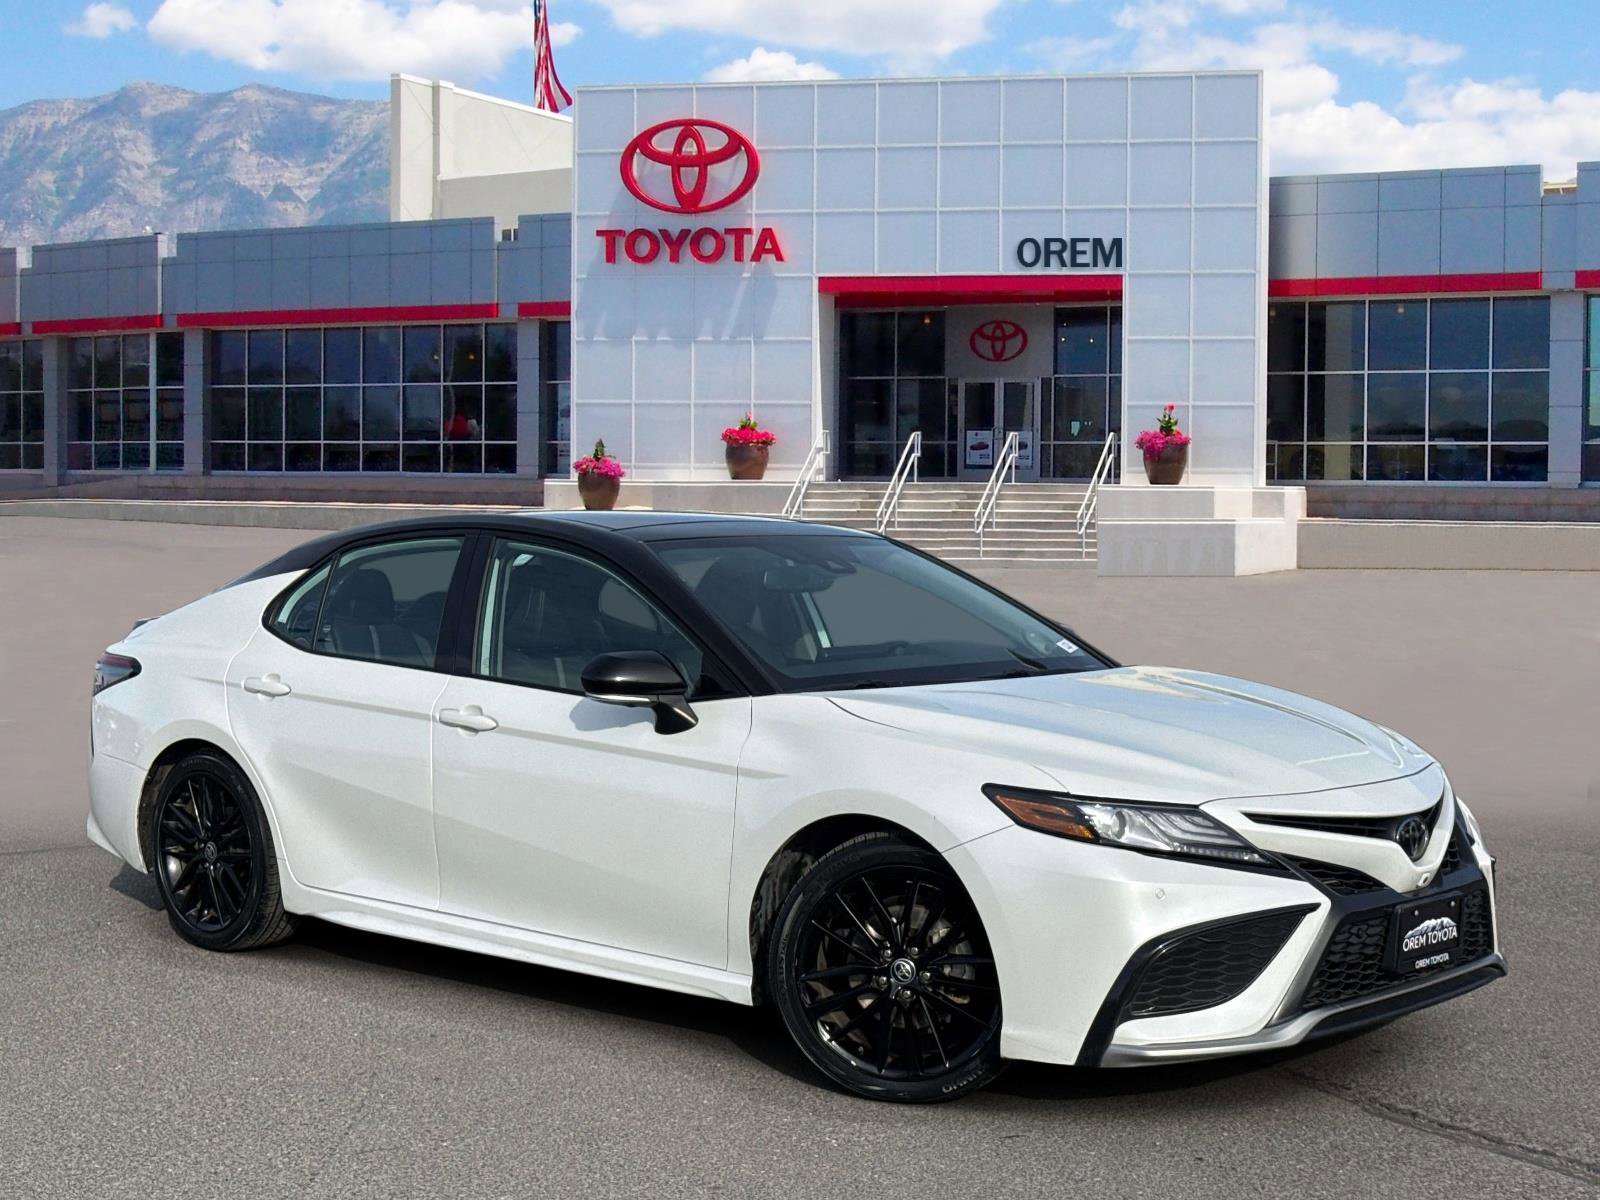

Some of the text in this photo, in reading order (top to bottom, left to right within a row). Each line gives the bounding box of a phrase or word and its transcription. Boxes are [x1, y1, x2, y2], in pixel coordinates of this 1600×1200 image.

[596, 227, 785, 264] TOYOTA
[1017, 237, 1123, 268] OREM
[1402, 926, 1458, 952] OREM TOYOTA
[1415, 952, 1450, 969] OREM TOYOTA
